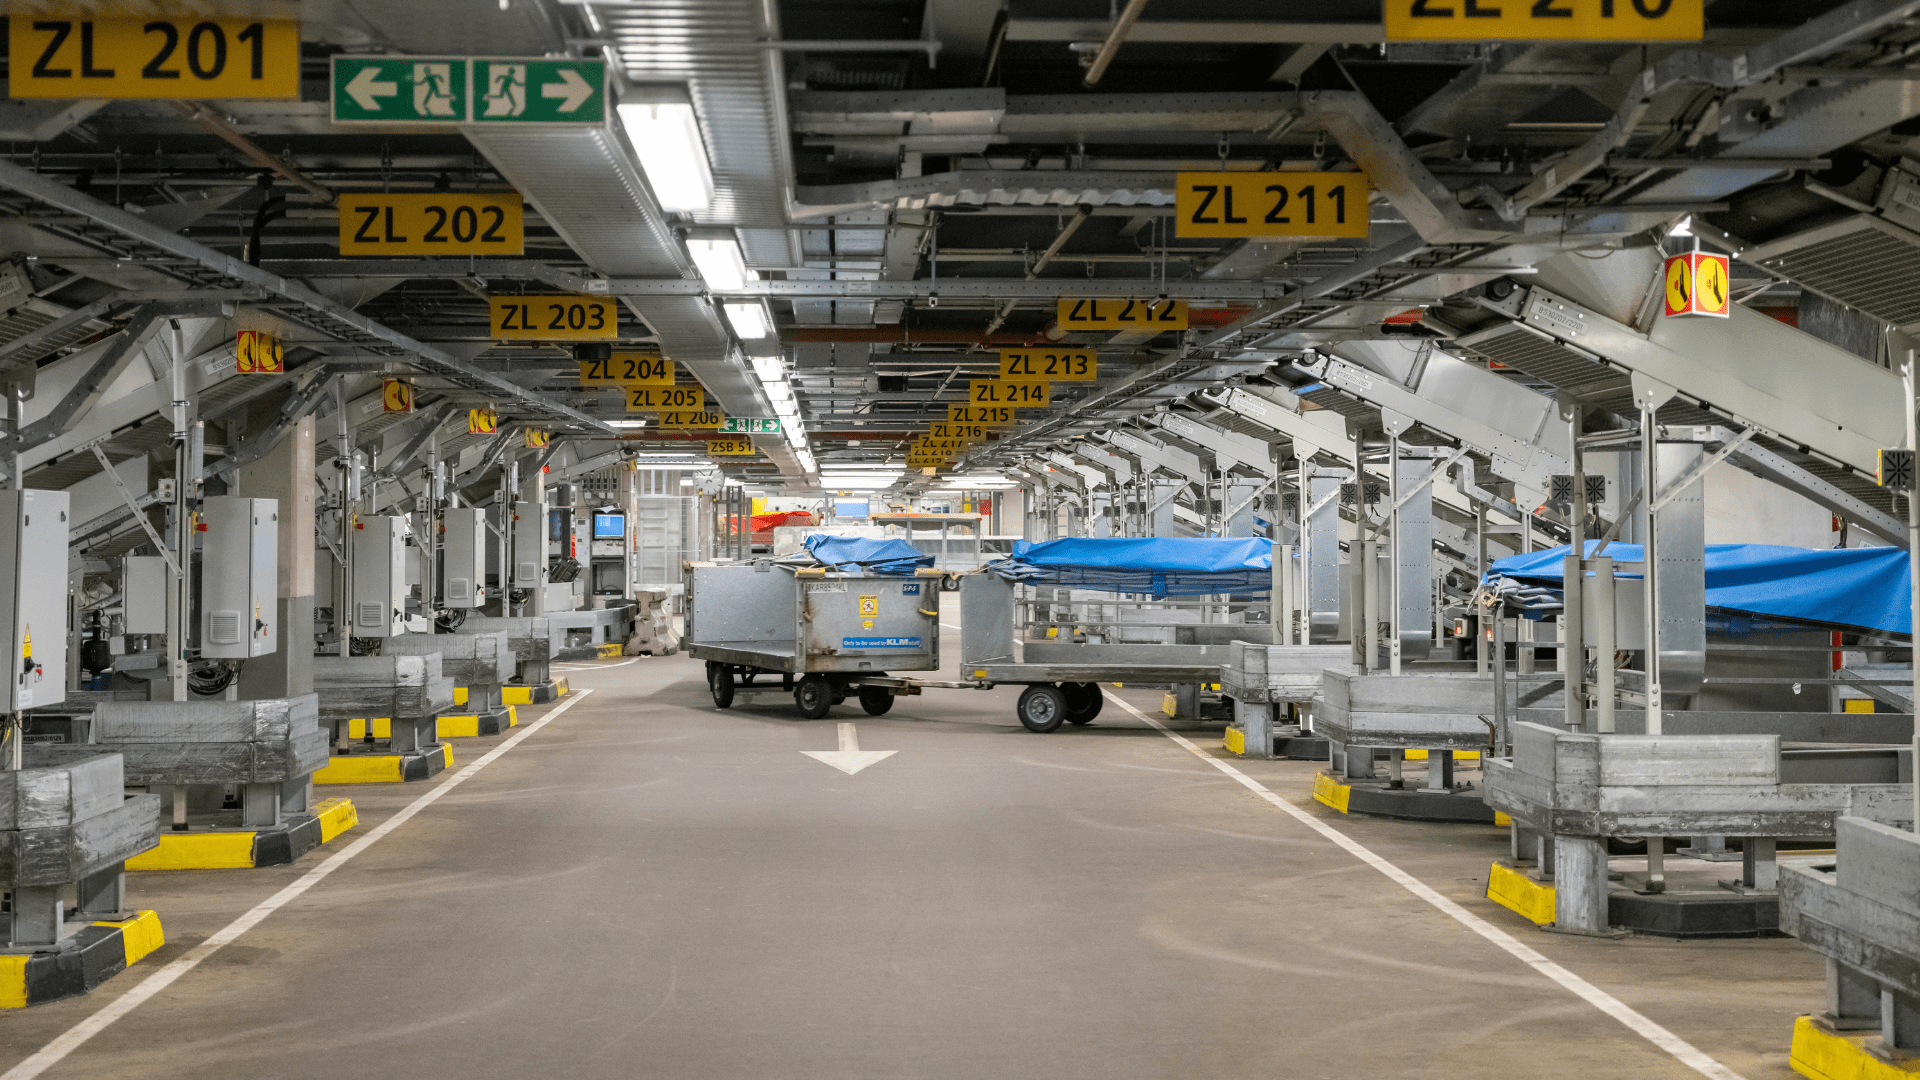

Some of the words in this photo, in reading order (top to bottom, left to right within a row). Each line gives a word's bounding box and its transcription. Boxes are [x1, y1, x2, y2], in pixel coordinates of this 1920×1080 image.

[32, 22, 115, 79] ZL
[142, 22, 264, 79] 201
[1192, 186, 1248, 223] ZL
[1265, 185, 1345, 223] 211
[354, 206, 407, 242] ZL
[424, 206, 505, 242] 202
[501, 305, 538, 329] ZL
[549, 304, 605, 330] 203
[1069, 300, 1107, 321] ZL
[1118, 300, 1176, 321] 212
[587, 360, 615, 379] ZL
[623, 360, 666, 379] 204
[1008, 355, 1036, 374] ZL
[1045, 355, 1088, 374] 213
[633, 391, 655, 406] ZL
[662, 390, 697, 406] 205
[977, 385, 1000, 402] ZL
[1007, 385, 1043, 402] 214
[664, 413, 683, 424] ZL
[689, 413, 719, 425] 206
[954, 408, 973, 421] ZL
[979, 408, 1009, 422] 215
[935, 426, 951, 437] ZL
[956, 426, 982, 437] 216
[711, 442, 734, 453] ZSB
[738, 441, 752, 452] 51
[922, 437, 937, 447] ZL
